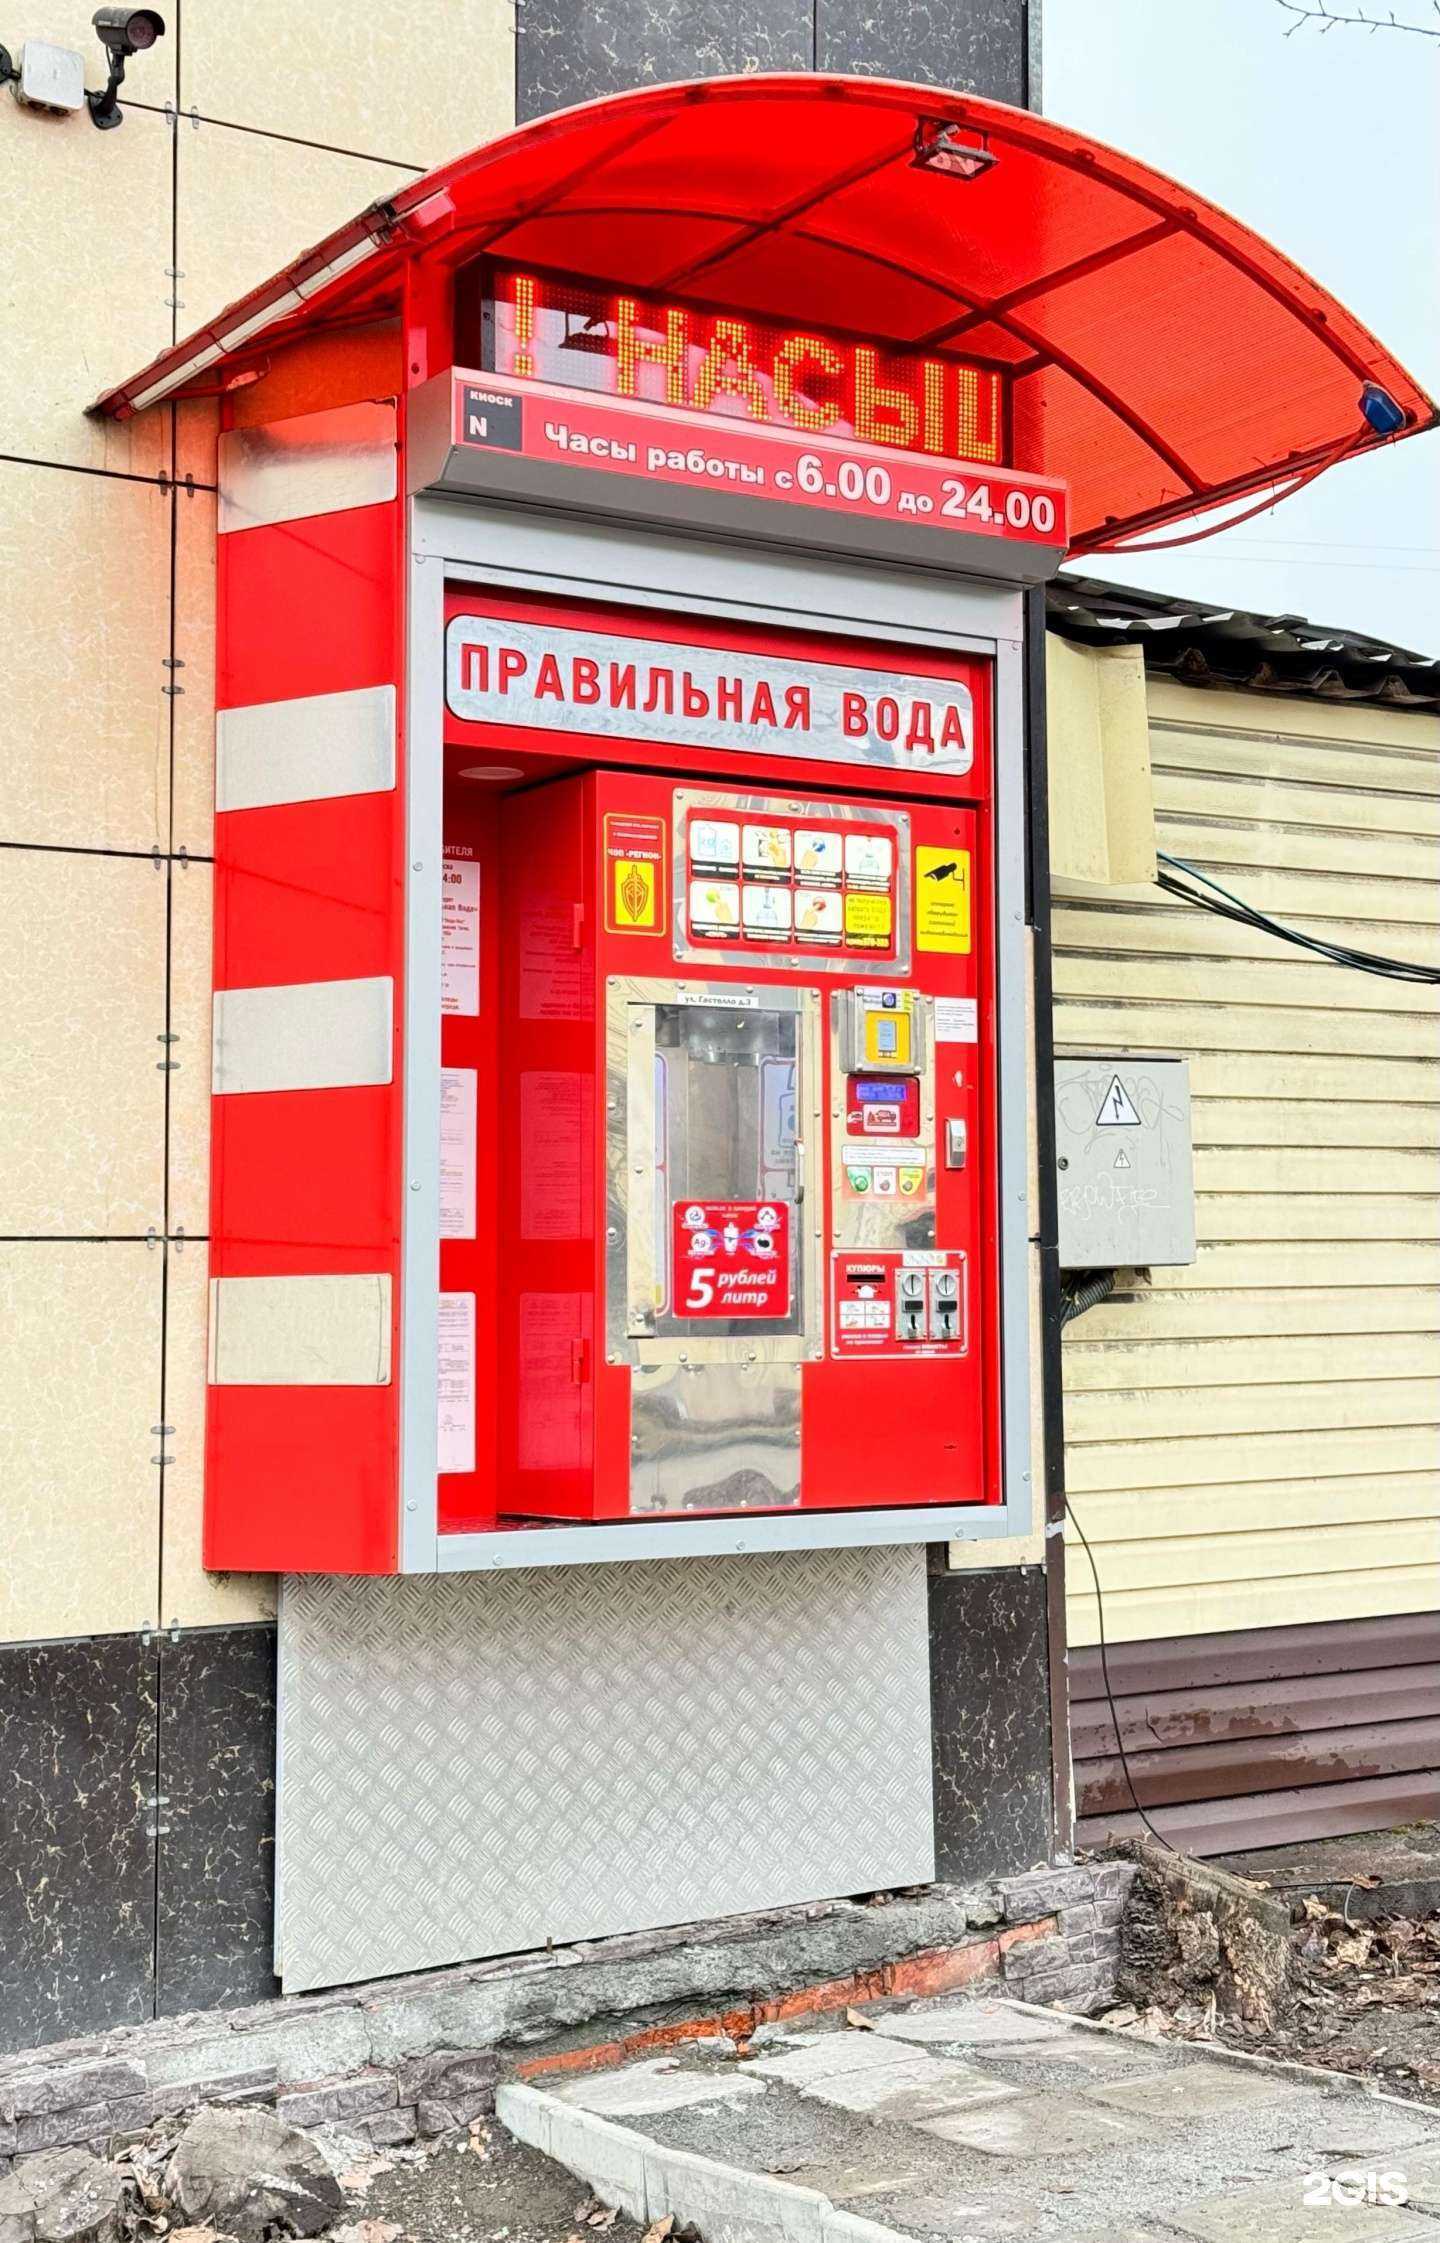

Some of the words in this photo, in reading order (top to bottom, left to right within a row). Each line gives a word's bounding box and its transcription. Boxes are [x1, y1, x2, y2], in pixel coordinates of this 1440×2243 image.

[468, 414, 488, 438] N
[544, 420, 637, 463] Часы
[646, 447, 765, 485] работы
[795, 452, 891, 505] 6.00
[897, 489, 934, 515] до
[940, 478, 1056, 533] 24.00
[461, 642, 811, 731] ПРАВИЛЬНАЯ
[842, 692, 966, 754] ВОДА
[846, 1264, 885, 1273] КУПЮРЫ
[686, 1268, 715, 1308] 5
[717, 1268, 777, 1289] рублей
[721, 1291, 768, 1307] литр
